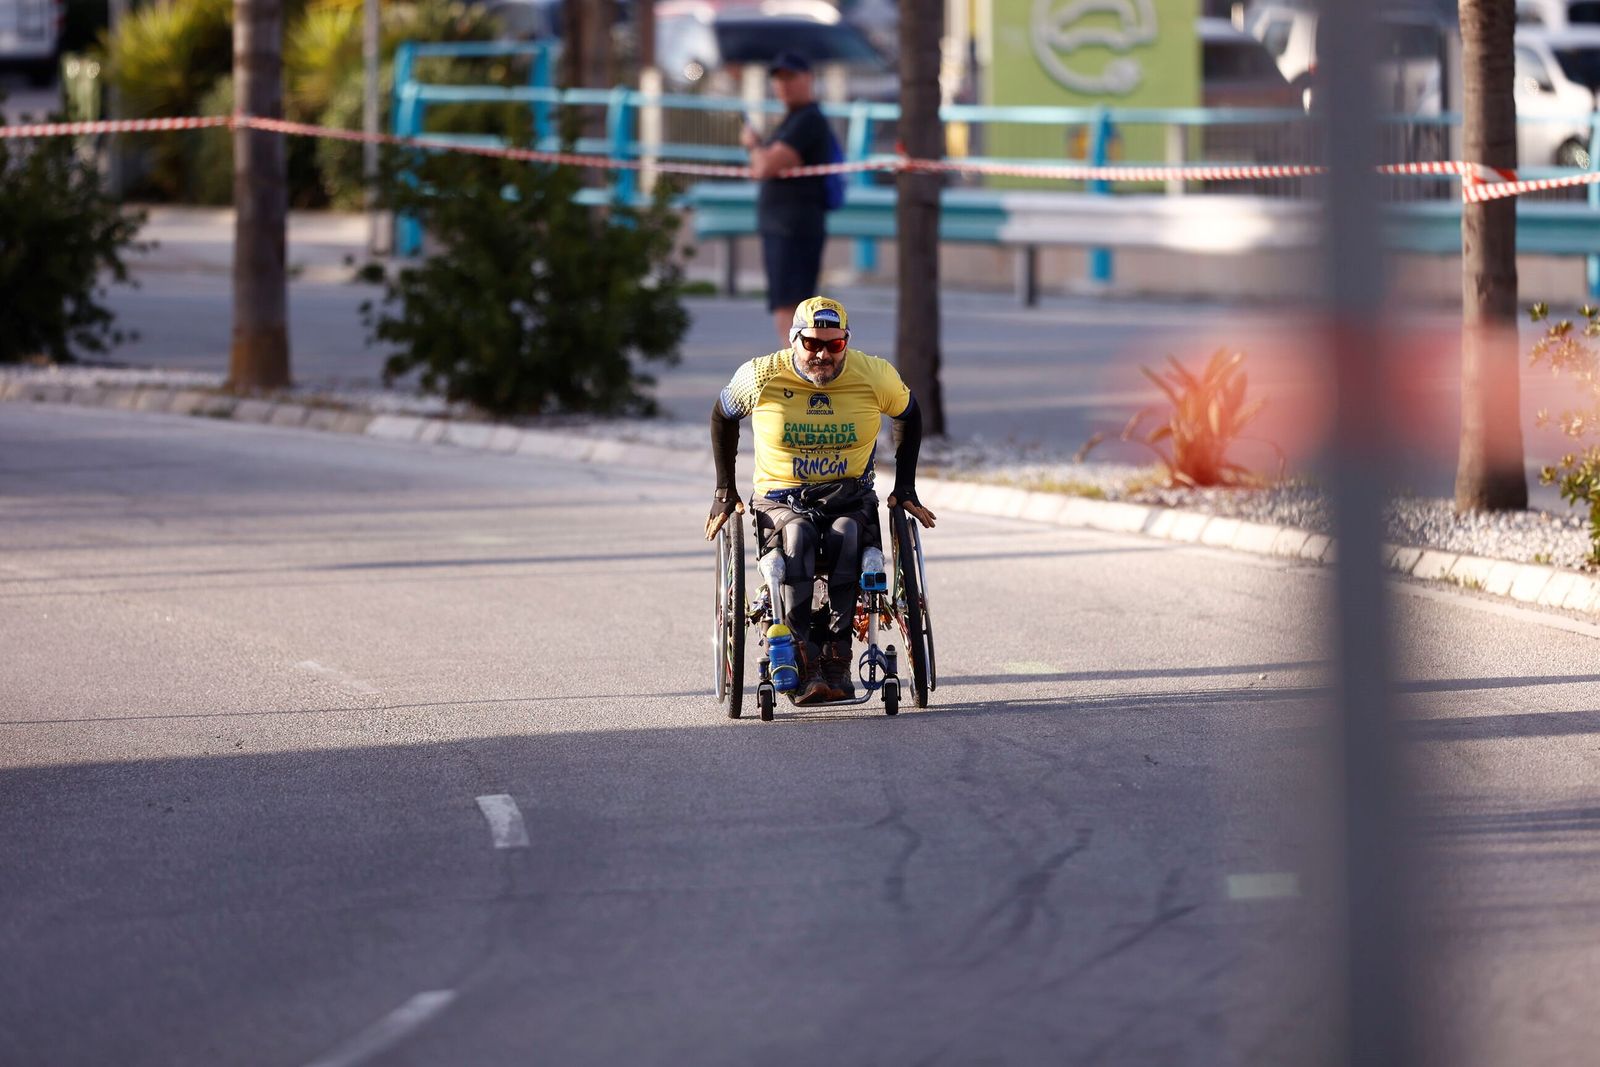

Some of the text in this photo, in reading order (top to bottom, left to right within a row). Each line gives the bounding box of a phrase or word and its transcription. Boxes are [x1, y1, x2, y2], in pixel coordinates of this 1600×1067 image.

[783, 422, 856, 433] CANILLAS DE
[782, 432, 858, 446] ALBAIDA
